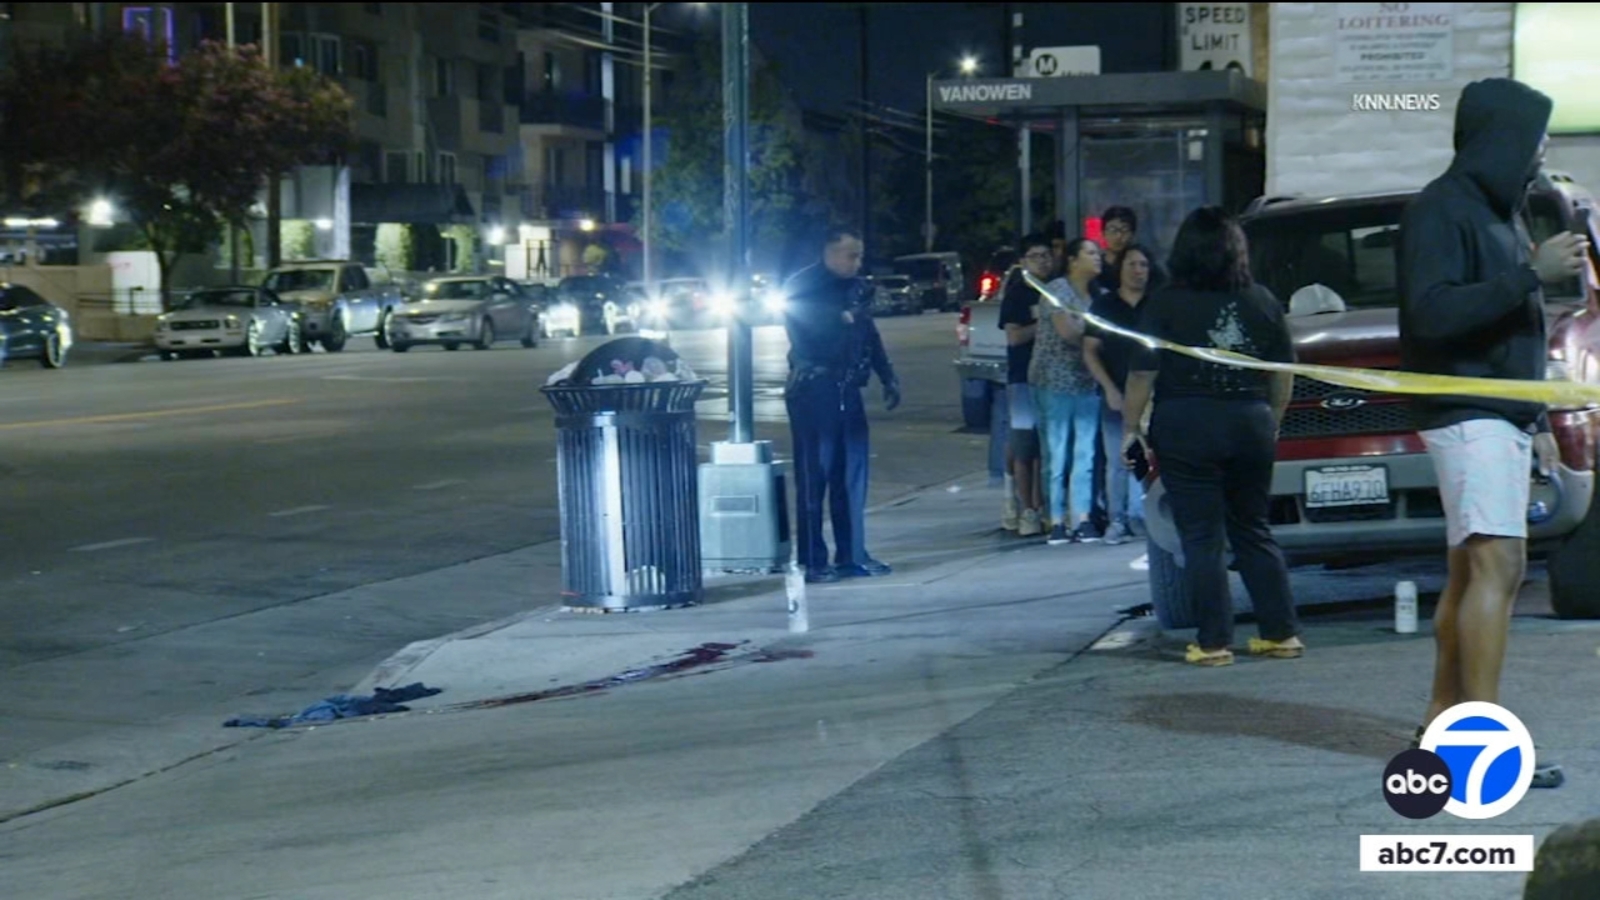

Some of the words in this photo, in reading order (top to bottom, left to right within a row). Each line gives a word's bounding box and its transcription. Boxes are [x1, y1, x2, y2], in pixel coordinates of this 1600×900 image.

[1185, 6, 1246, 24] SPEED
[1379, 3, 1410, 13] NO
[1337, 14, 1451, 30] LOITERING
[1191, 33, 1240, 51] LIMIT
[939, 83, 1032, 104] VANOWEN
